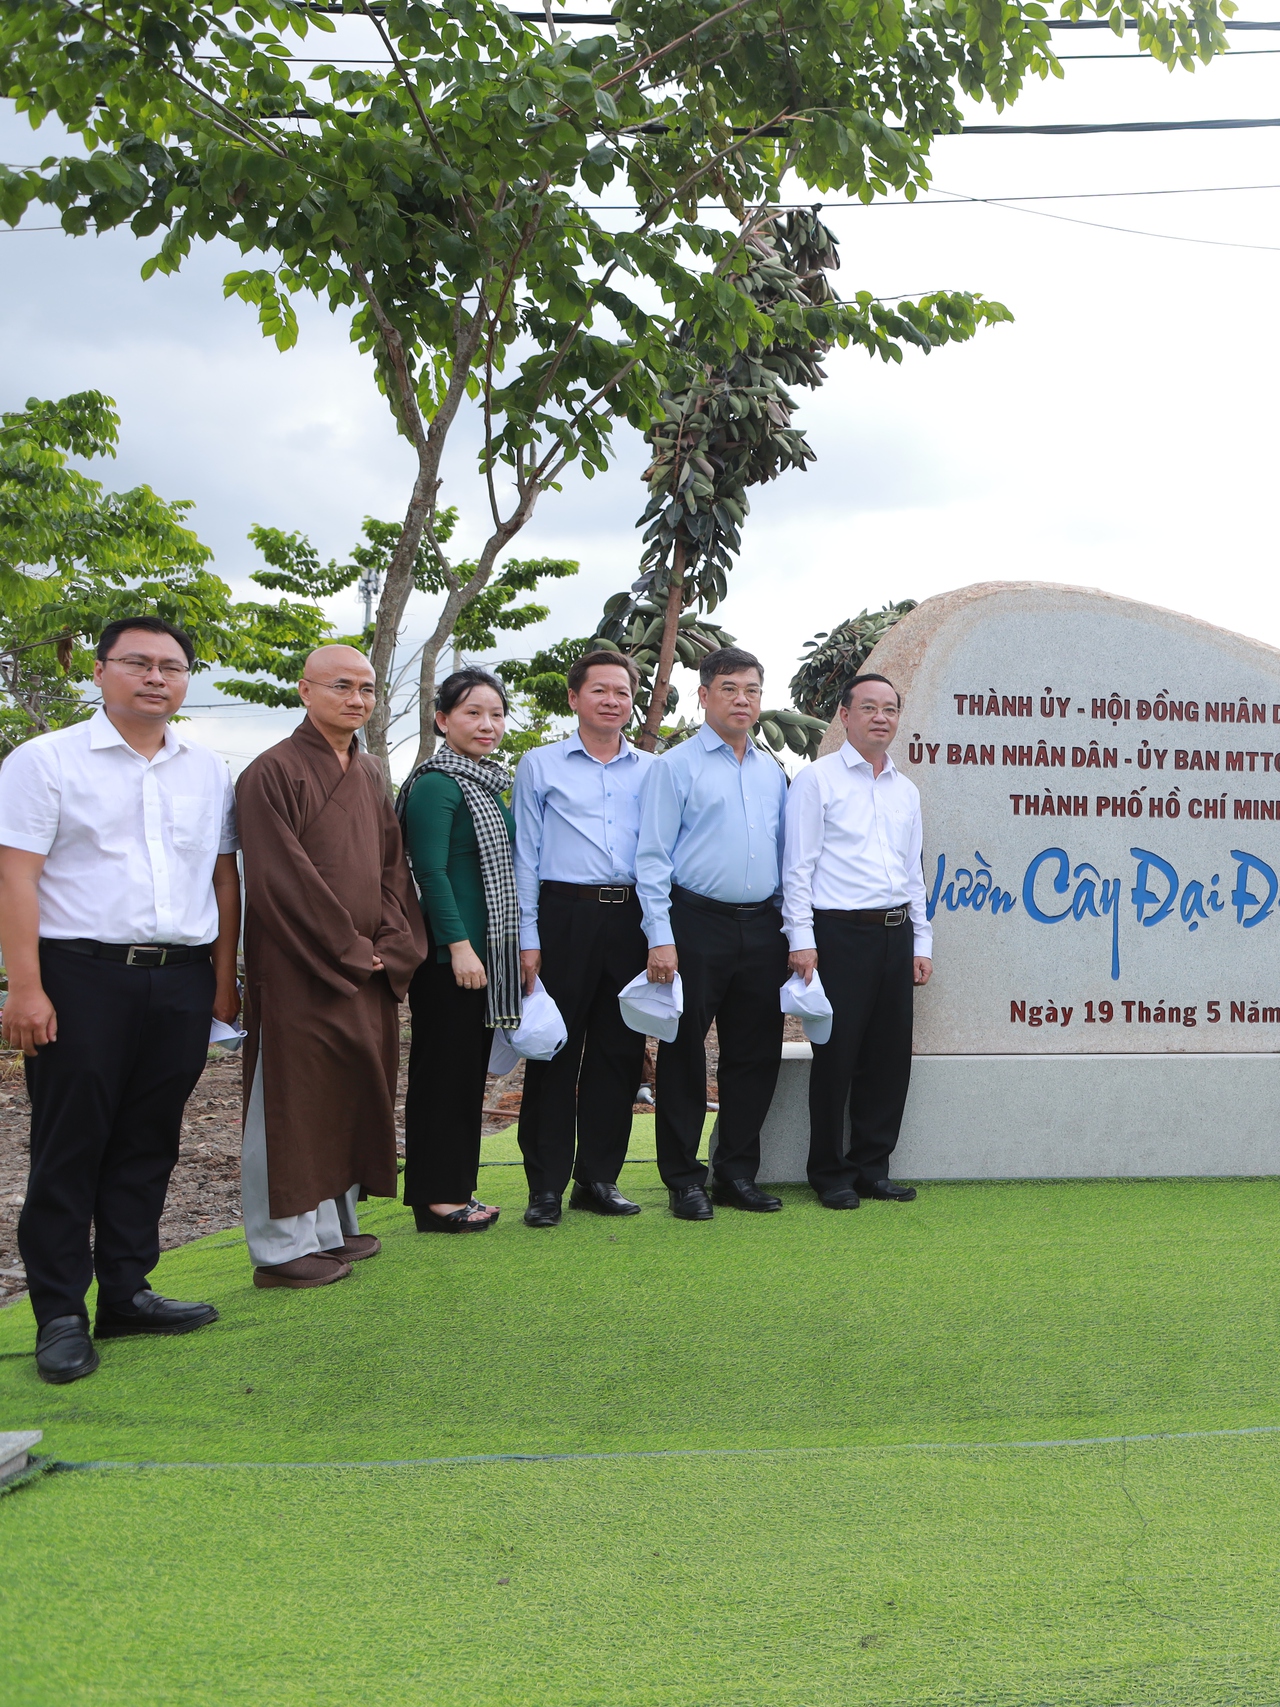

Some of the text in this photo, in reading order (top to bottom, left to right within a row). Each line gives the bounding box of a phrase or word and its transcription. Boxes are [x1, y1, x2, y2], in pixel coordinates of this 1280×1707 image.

[953, 688, 1033, 717] THÀNH
[1040, 686, 1071, 718] ỦY
[1091, 692, 1131, 727] HỘI
[1136, 688, 1199, 722] ĐỒNG
[1205, 696, 1266, 724] NHÂN
[908, 733, 941, 765] ỦY
[947, 743, 995, 766] BAN
[1002, 739, 1066, 767] NHÂN
[1071, 740, 1118, 768] DÂN
[1137, 739, 1169, 770] ỦY
[1174, 749, 1220, 771] BAN
[1009, 787, 1088, 817] THÀNH
[1096, 785, 1148, 818] PHỐ
[1149, 786, 1181, 819] HỒ
[1188, 792, 1228, 820] CHÍ
[1022, 847, 1121, 981] Cây
[1129, 847, 1225, 932] Đại
[1010, 999, 1074, 1027] Ngày
[1084, 1000, 1114, 1023] 19
[1121, 999, 1198, 1028] Tháng
[1207, 1000, 1221, 1023] 5
